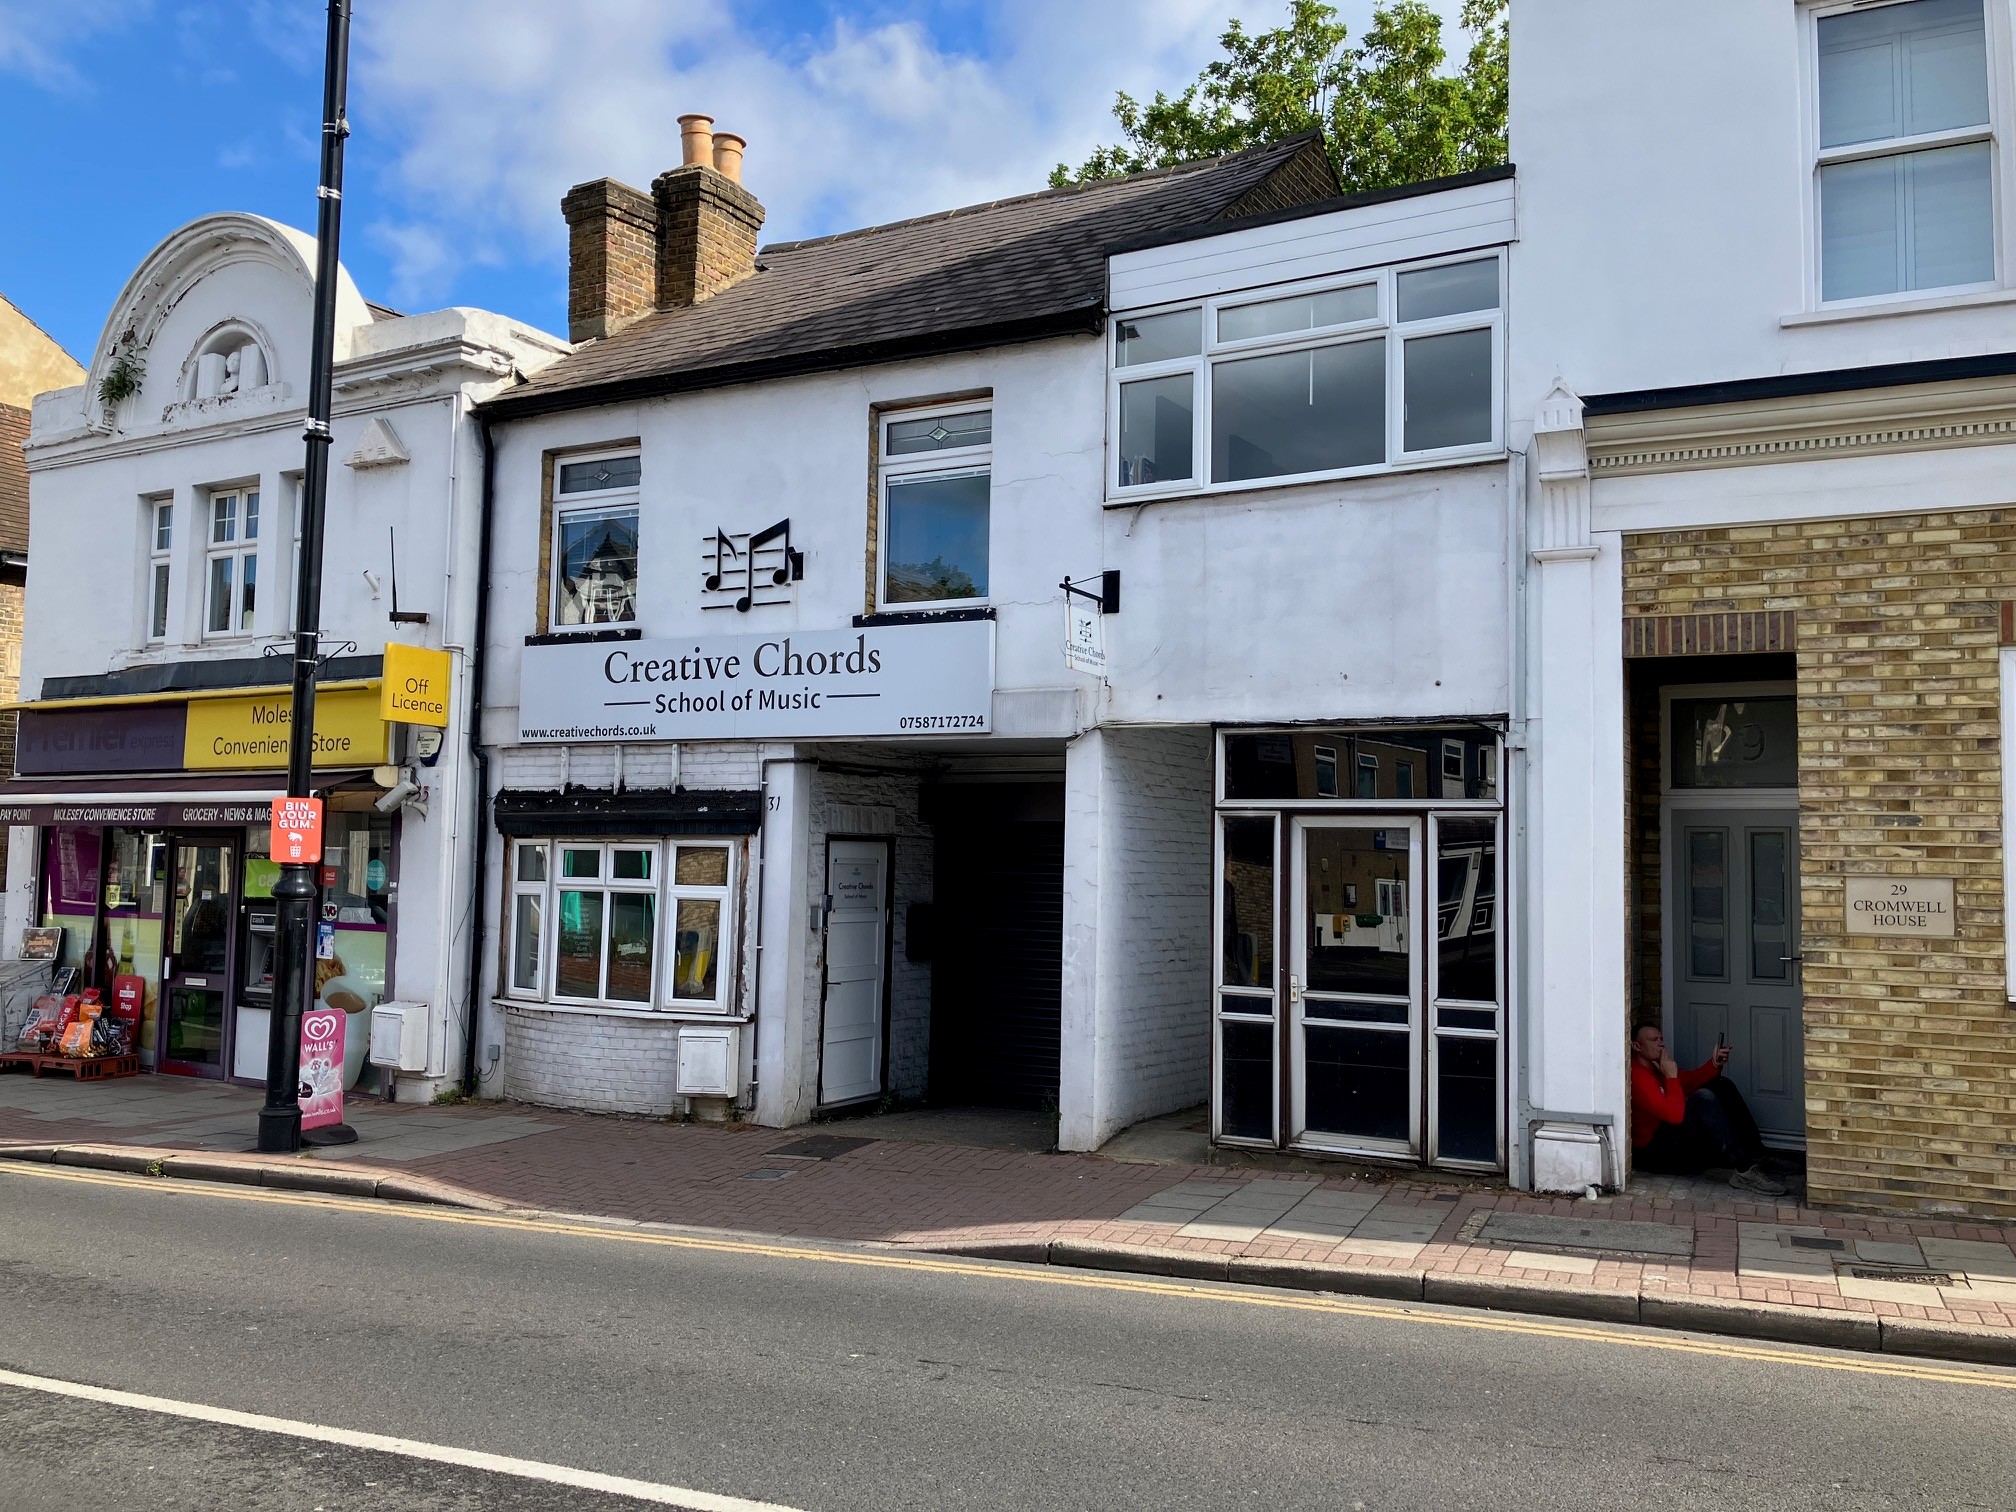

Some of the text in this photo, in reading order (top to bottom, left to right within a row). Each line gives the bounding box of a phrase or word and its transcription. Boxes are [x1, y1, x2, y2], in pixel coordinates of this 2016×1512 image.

[1066, 640, 1105, 660] Creative Chords
[604, 633, 881, 684] Creative Chords
[405, 677, 430, 695] Off
[392, 693, 443, 714] Licence
[655, 686, 822, 715] School of Music
[252, 703, 292, 724] Moles
[899, 714, 985, 730] 07587172724
[521, 723, 657, 738] www.creativechords.co.uk
[213, 733, 351, 755] Convenien Store
[285, 801, 309, 811] BIN
[768, 796, 781, 811] 31
[0, 808, 32, 821] PAY POINT
[53, 808, 157, 821] MOLESEY CONVENIENCE STORE
[182, 807, 219, 821] GROCERY
[223, 807, 246, 821] NEWS
[245, 807, 253, 820] &
[254, 808, 272, 821] MAG
[277, 810, 317, 820] YOUR
[278, 819, 315, 829] GUM.
[258, 872, 279, 887] ca
[1891, 884, 1907, 896] 29
[1853, 900, 1947, 914] CROMWELL
[1873, 914, 1927, 927] HOUSE
[120, 1002, 132, 1012] Shop
[304, 1042, 335, 1053] WALL'S
